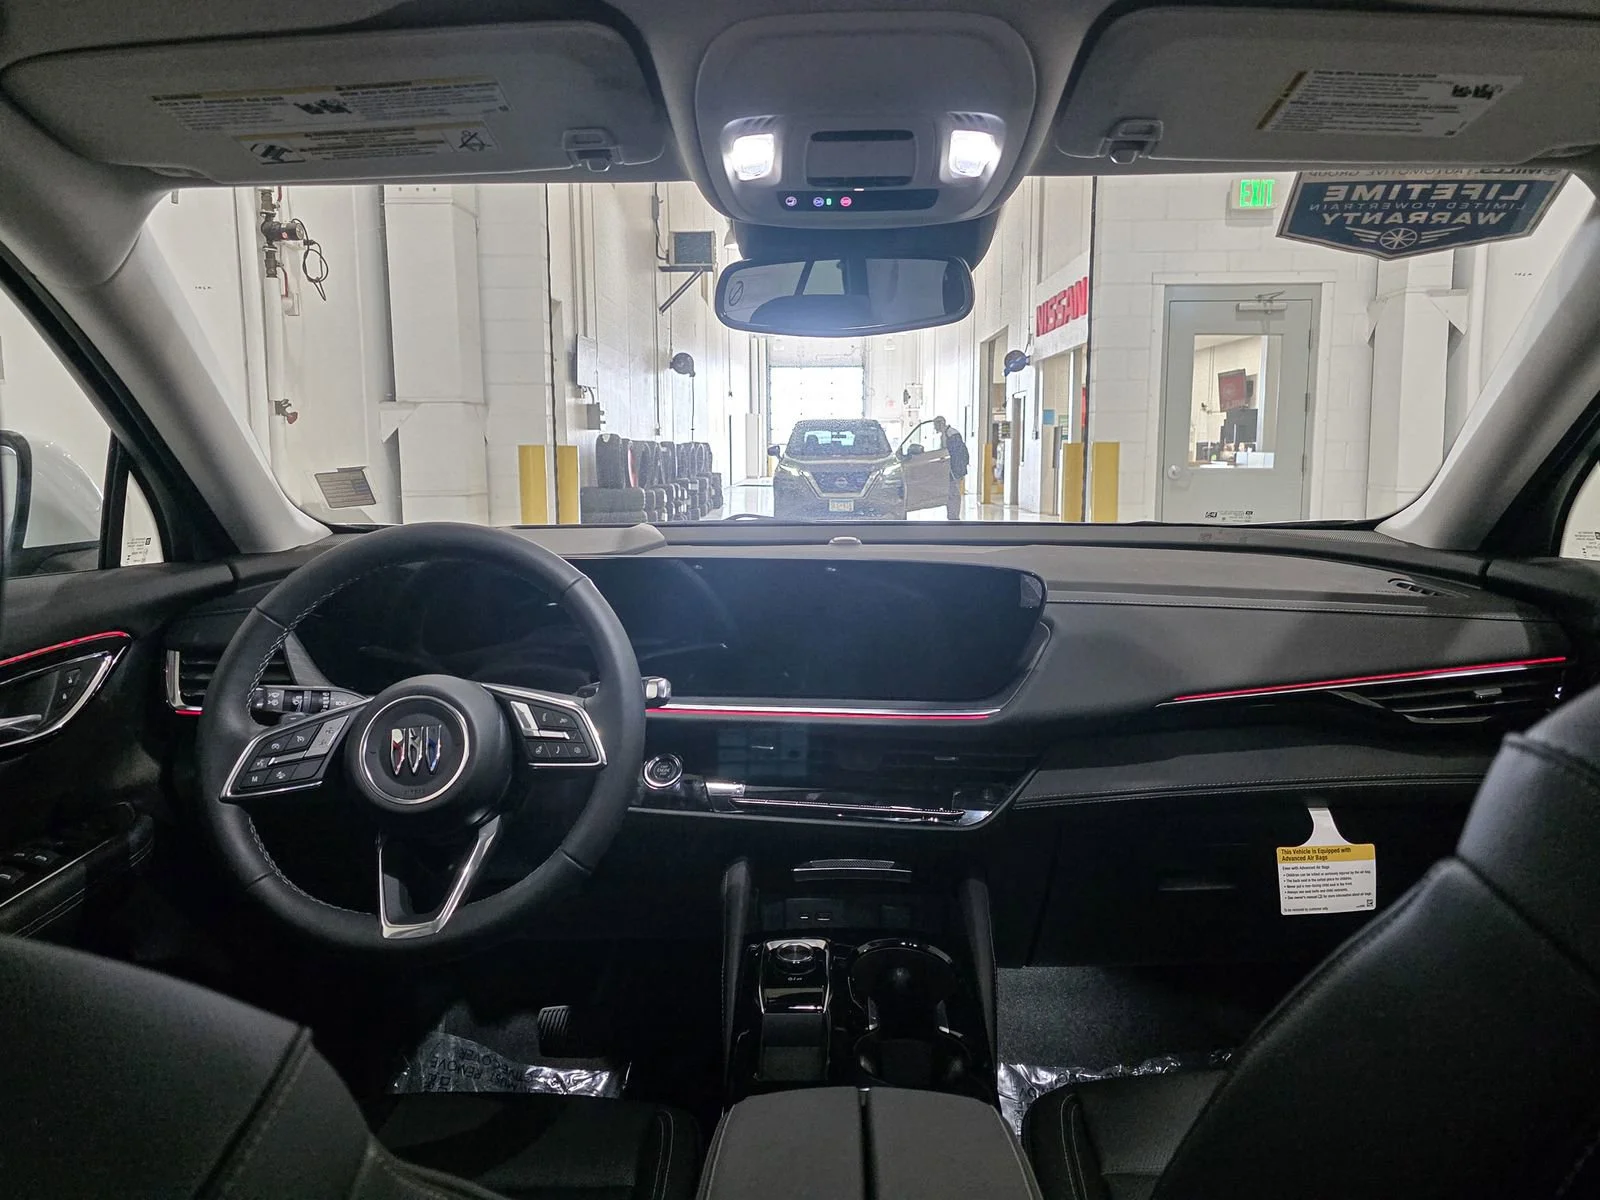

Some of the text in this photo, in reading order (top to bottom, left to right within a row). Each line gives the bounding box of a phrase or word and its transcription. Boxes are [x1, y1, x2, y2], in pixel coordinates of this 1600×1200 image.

[1240, 179, 1275, 207] EXIT
[1036, 276, 1088, 337] NISSAN
[251, 775, 259, 783] M
